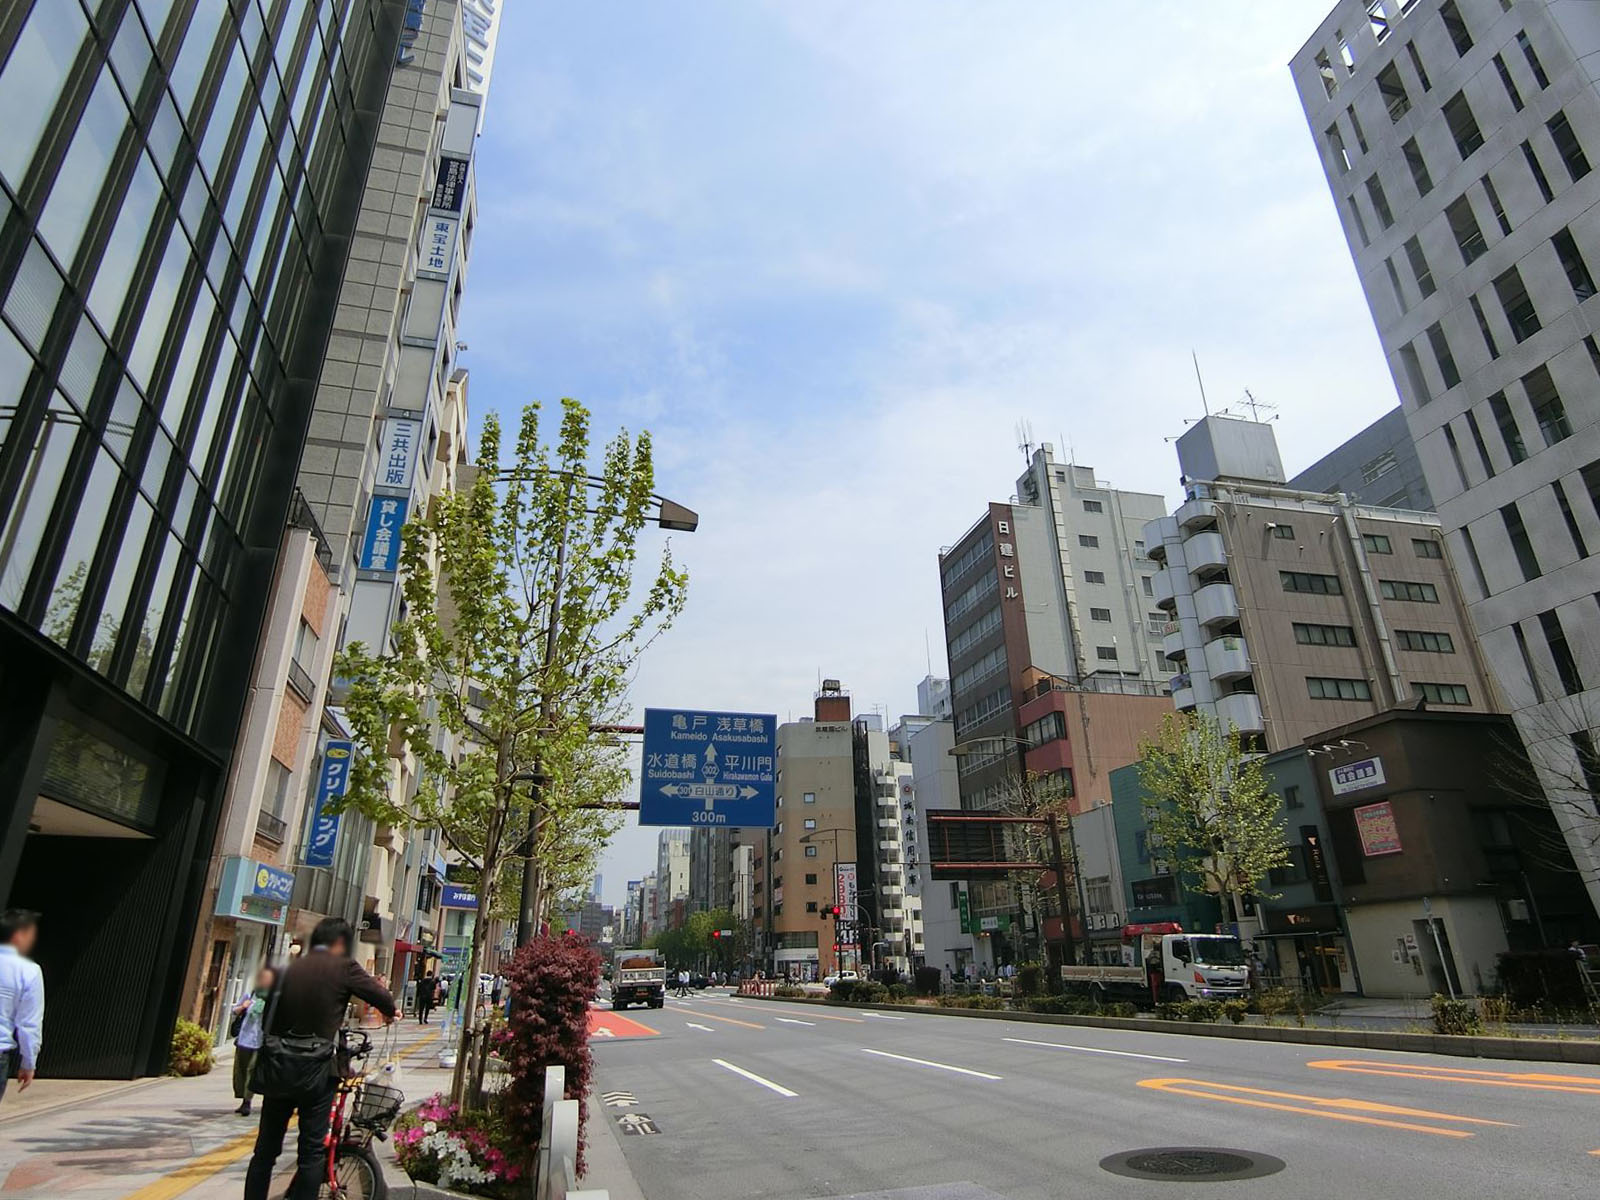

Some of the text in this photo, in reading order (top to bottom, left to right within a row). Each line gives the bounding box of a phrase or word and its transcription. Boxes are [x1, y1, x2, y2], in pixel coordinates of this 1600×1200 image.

[428, 222, 450, 268] 東宝土地
[385, 422, 412, 485] 三共出版
[369, 500, 398, 570] 貸し会議室
[998, 520, 1018, 599] 日建ビル
[672, 714, 764, 734] 亀戸 浅草橋
[671, 731, 768, 743] Kameido Asakusabashi
[647, 752, 697, 769] 水道橋
[725, 754, 773, 772] 平川門
[648, 769, 695, 780] Suidobashi
[704, 765, 717, 775] 302
[723, 772, 759, 781] Hirakawamon
[679, 785, 692, 795] 301
[695, 786, 734, 797] 白山通り
[692, 811, 726, 824] 300m
